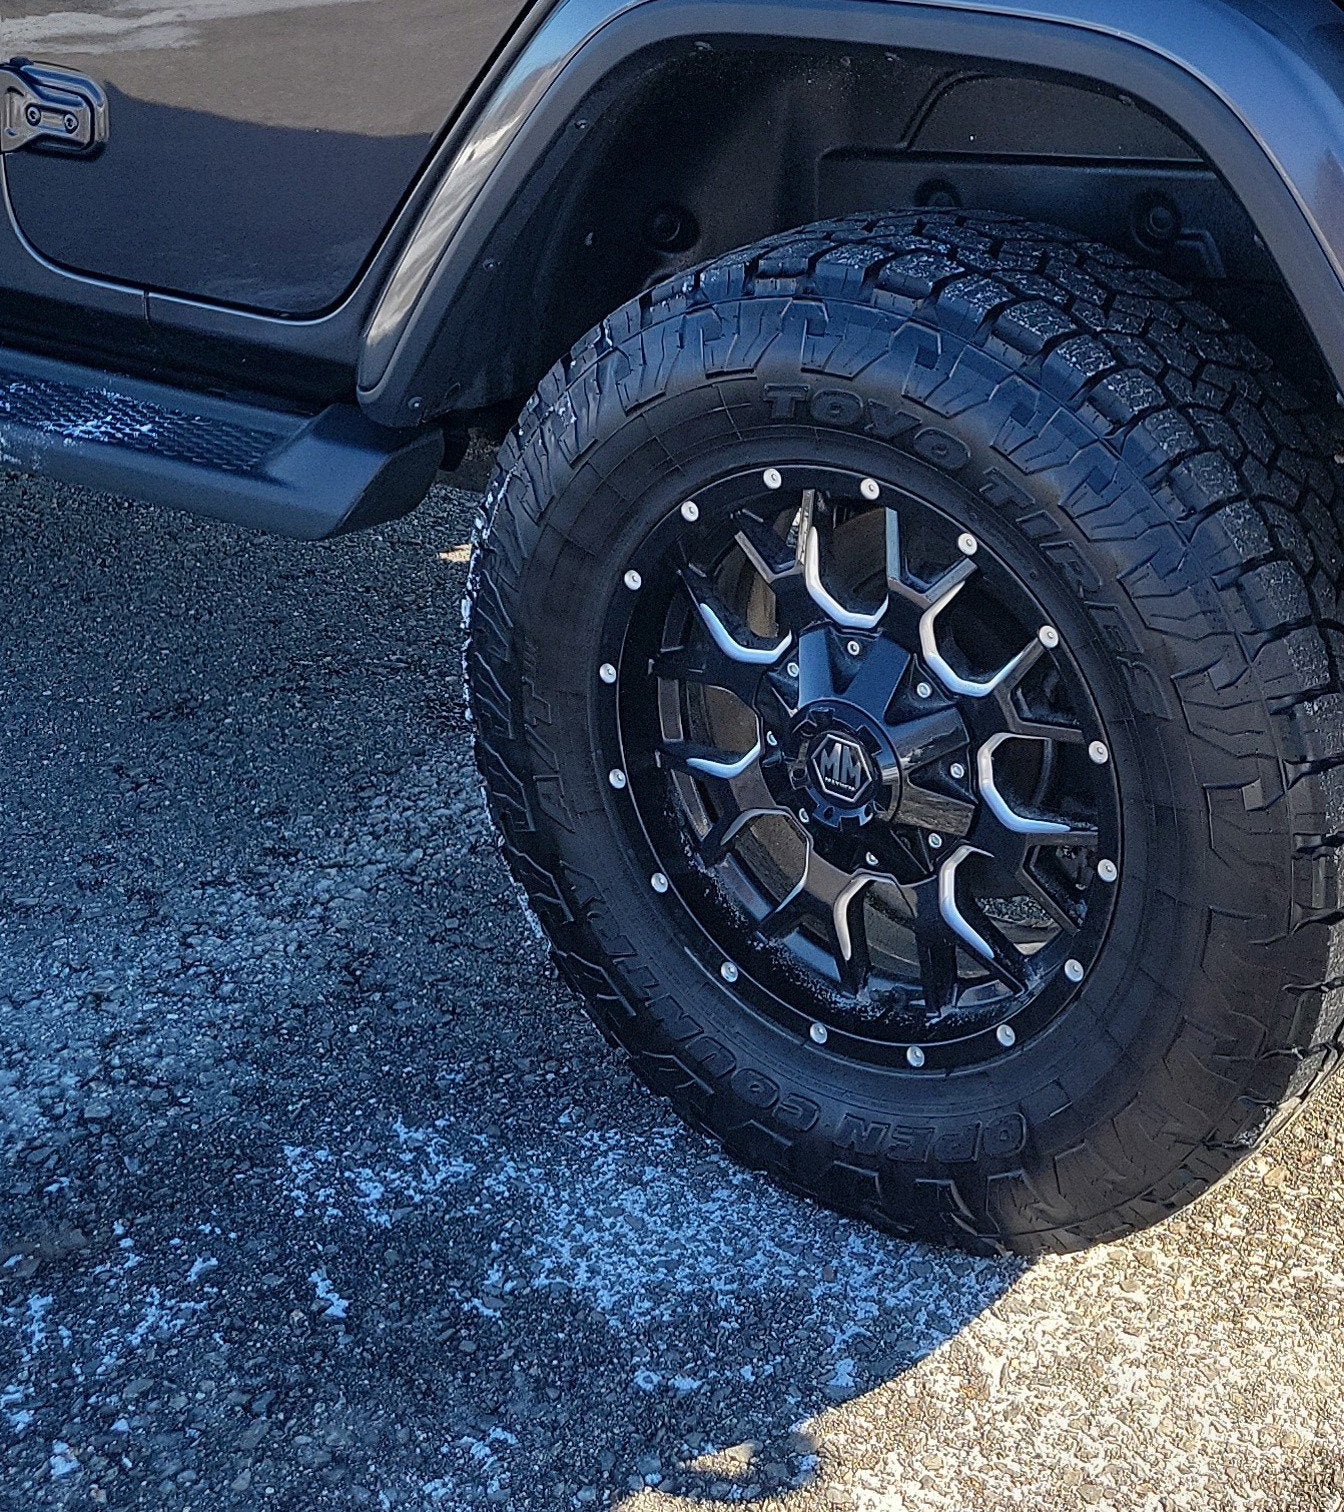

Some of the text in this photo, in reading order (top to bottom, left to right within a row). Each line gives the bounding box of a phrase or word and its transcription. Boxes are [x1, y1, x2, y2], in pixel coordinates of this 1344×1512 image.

[763, 383, 1174, 721] TOYO TIRES
[833, 1111, 1028, 1164] OPEN
